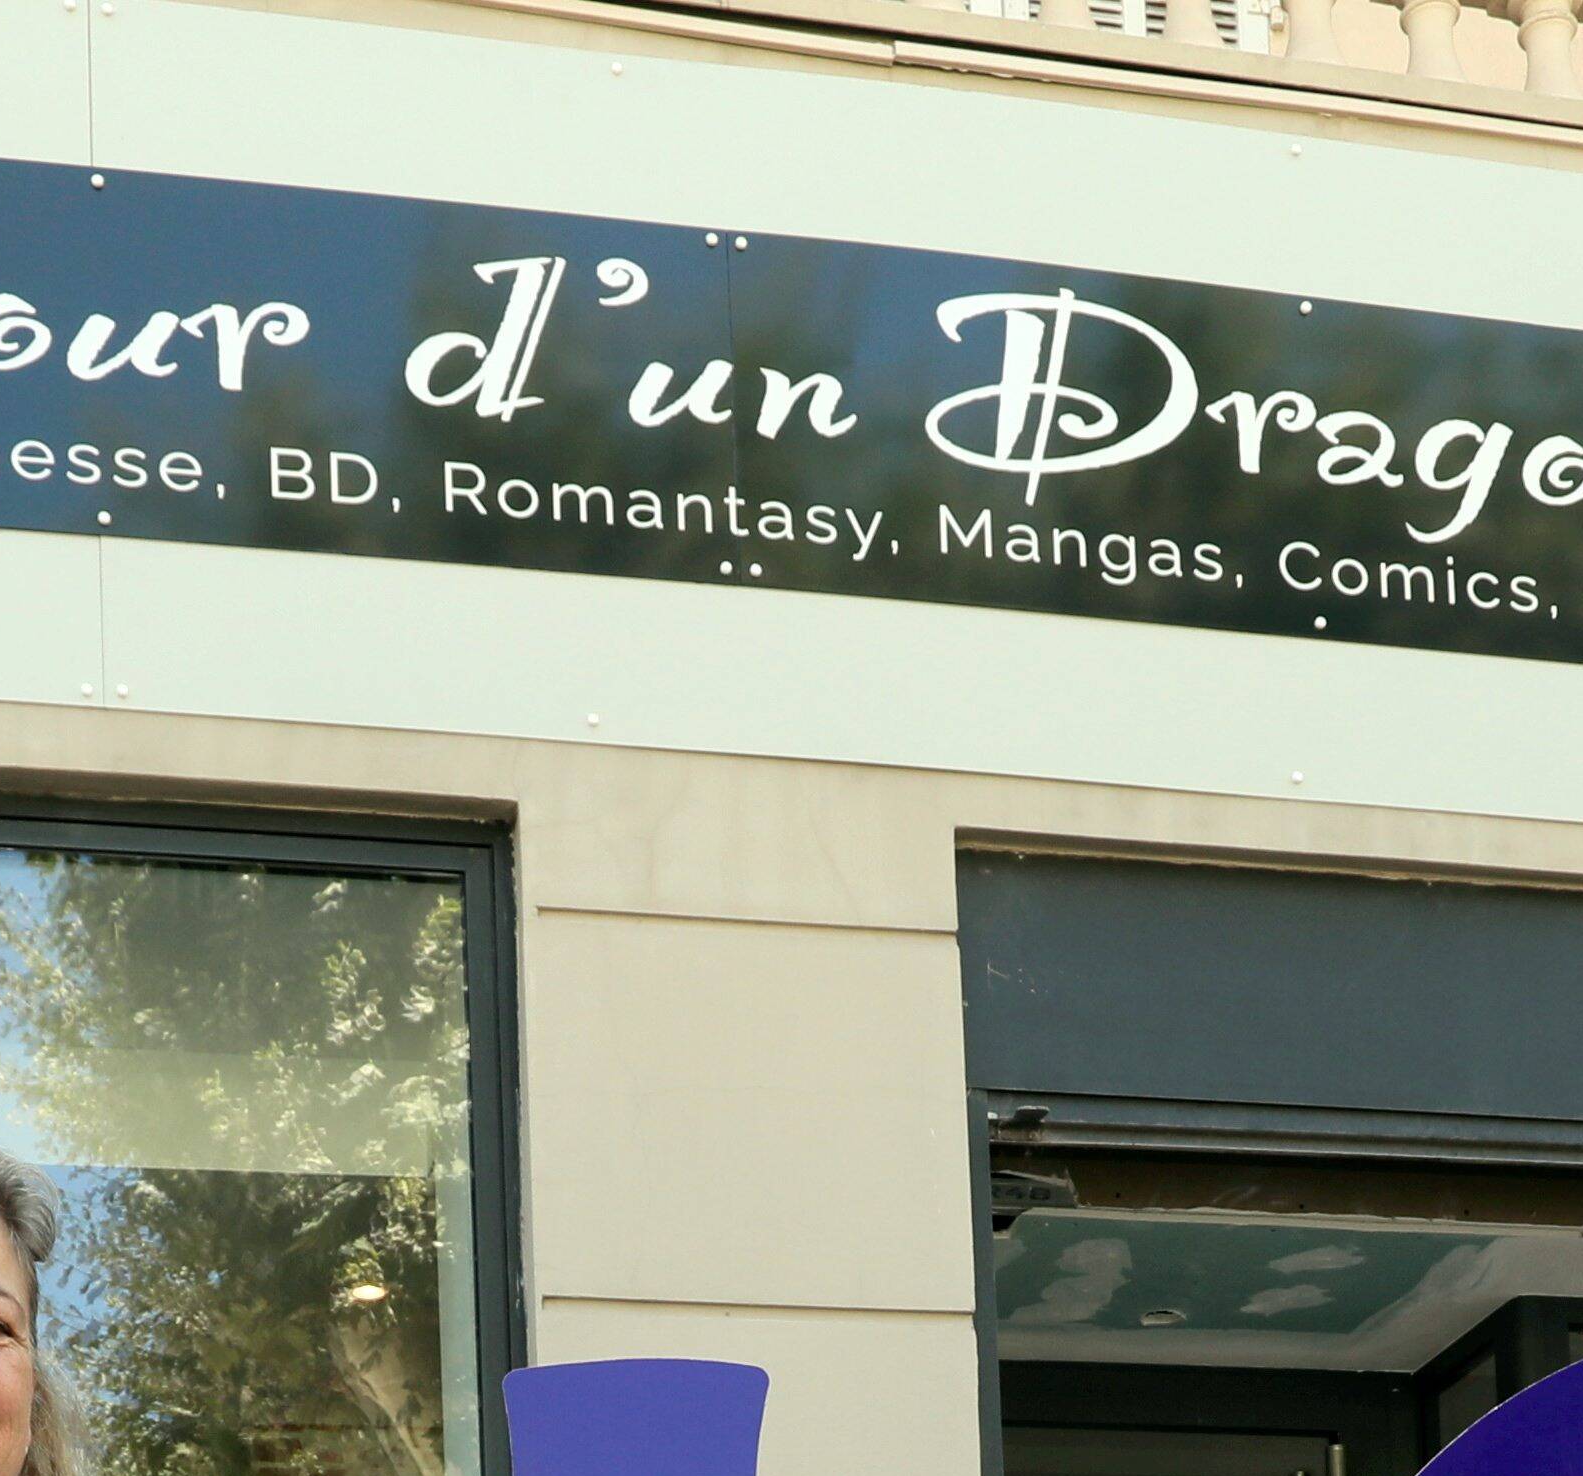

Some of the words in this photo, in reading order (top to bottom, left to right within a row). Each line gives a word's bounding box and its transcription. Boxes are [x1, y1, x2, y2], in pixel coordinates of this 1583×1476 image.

[404, 256, 857, 439] d'un
[270, 446, 400, 513] BD,
[444, 461, 899, 561] Romantasy,
[939, 504, 1246, 590] Mangas,
[1279, 541, 1560, 620] Comics,
